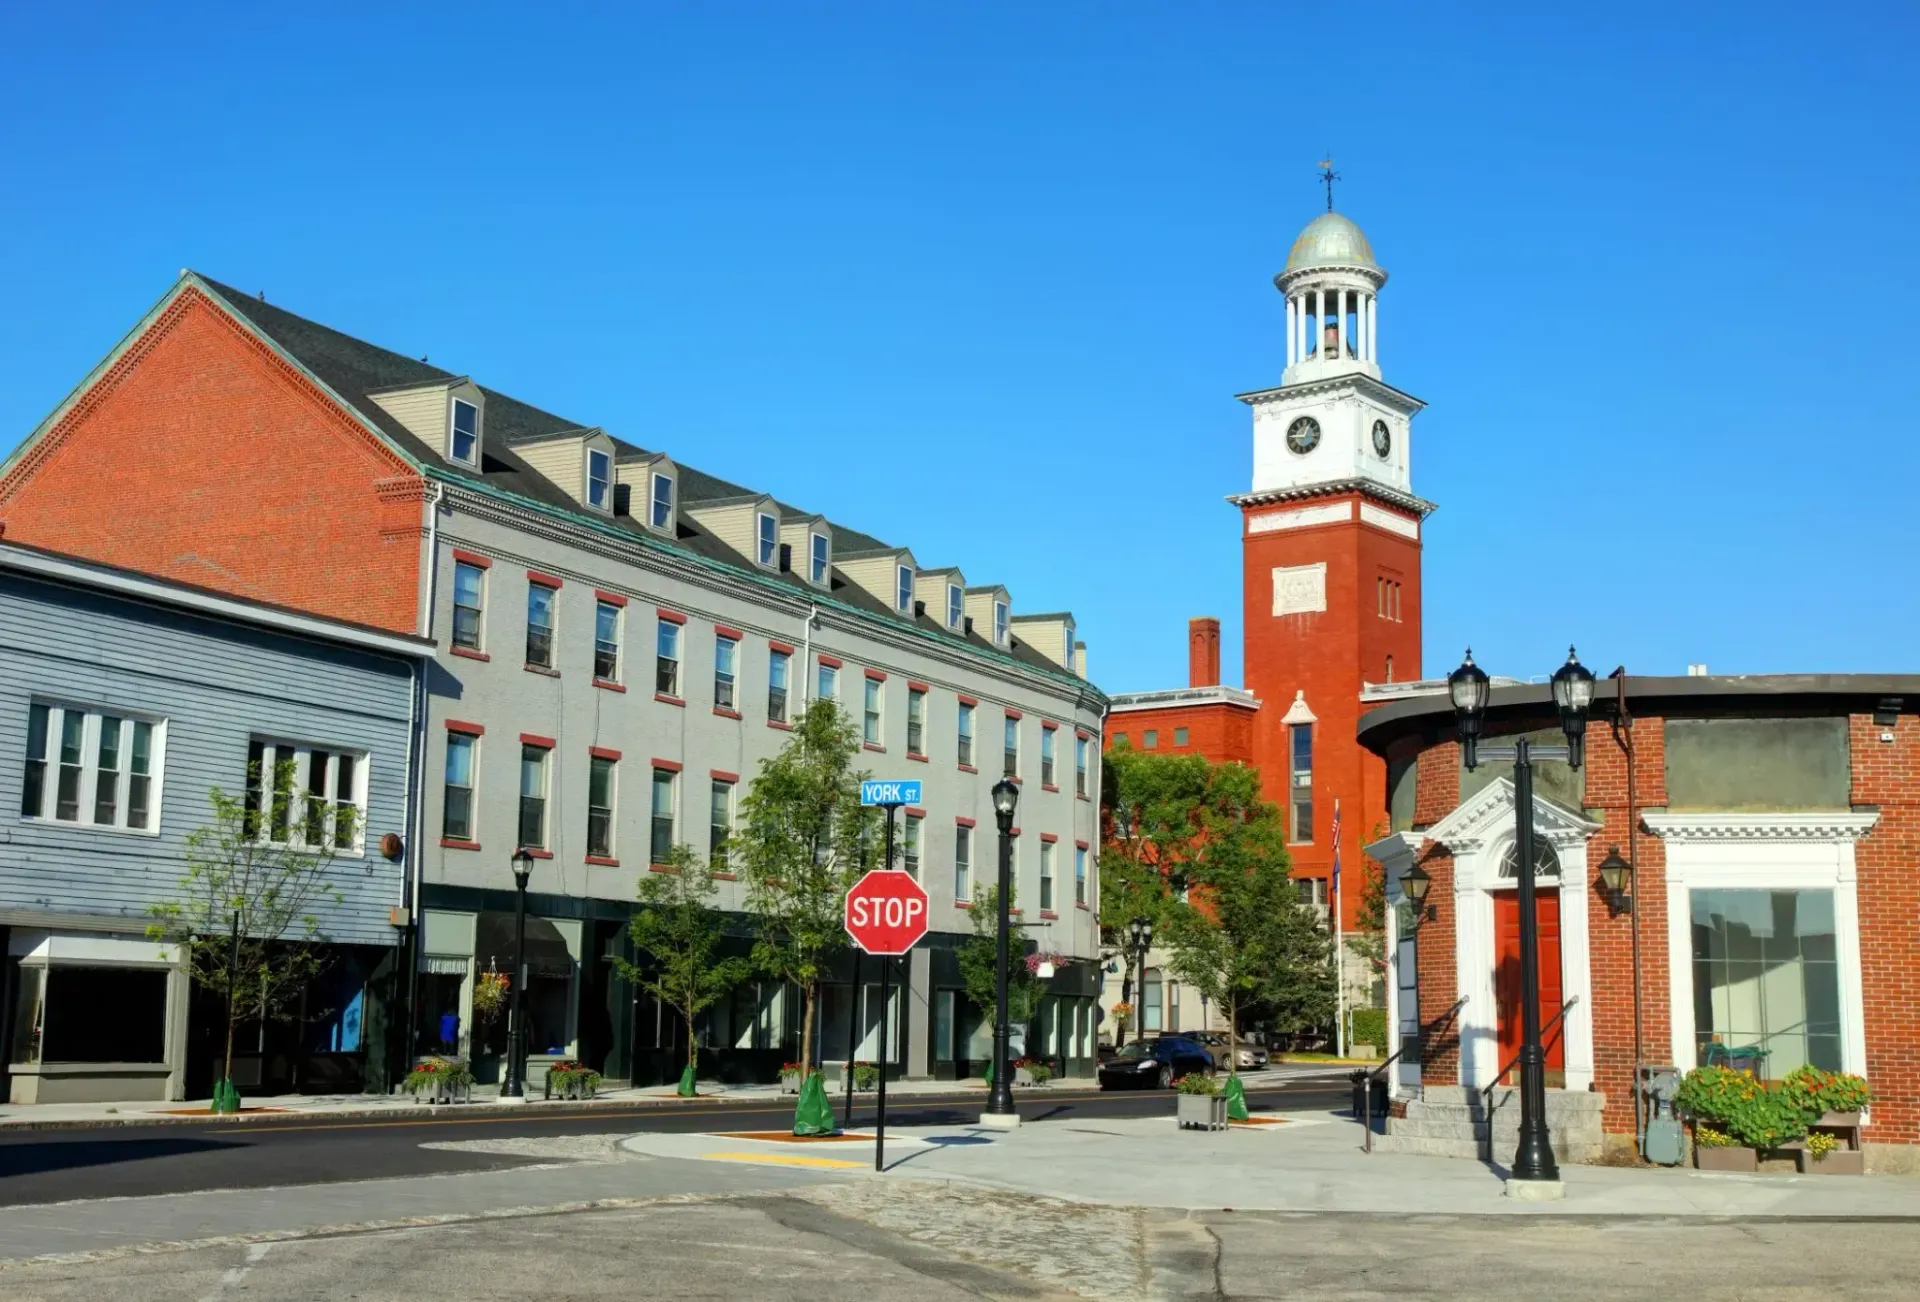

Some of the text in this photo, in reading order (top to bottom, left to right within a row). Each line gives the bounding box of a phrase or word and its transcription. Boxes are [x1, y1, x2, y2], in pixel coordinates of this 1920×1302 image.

[865, 784, 919, 802] YORK ST.
[852, 897, 923, 927] STOP
